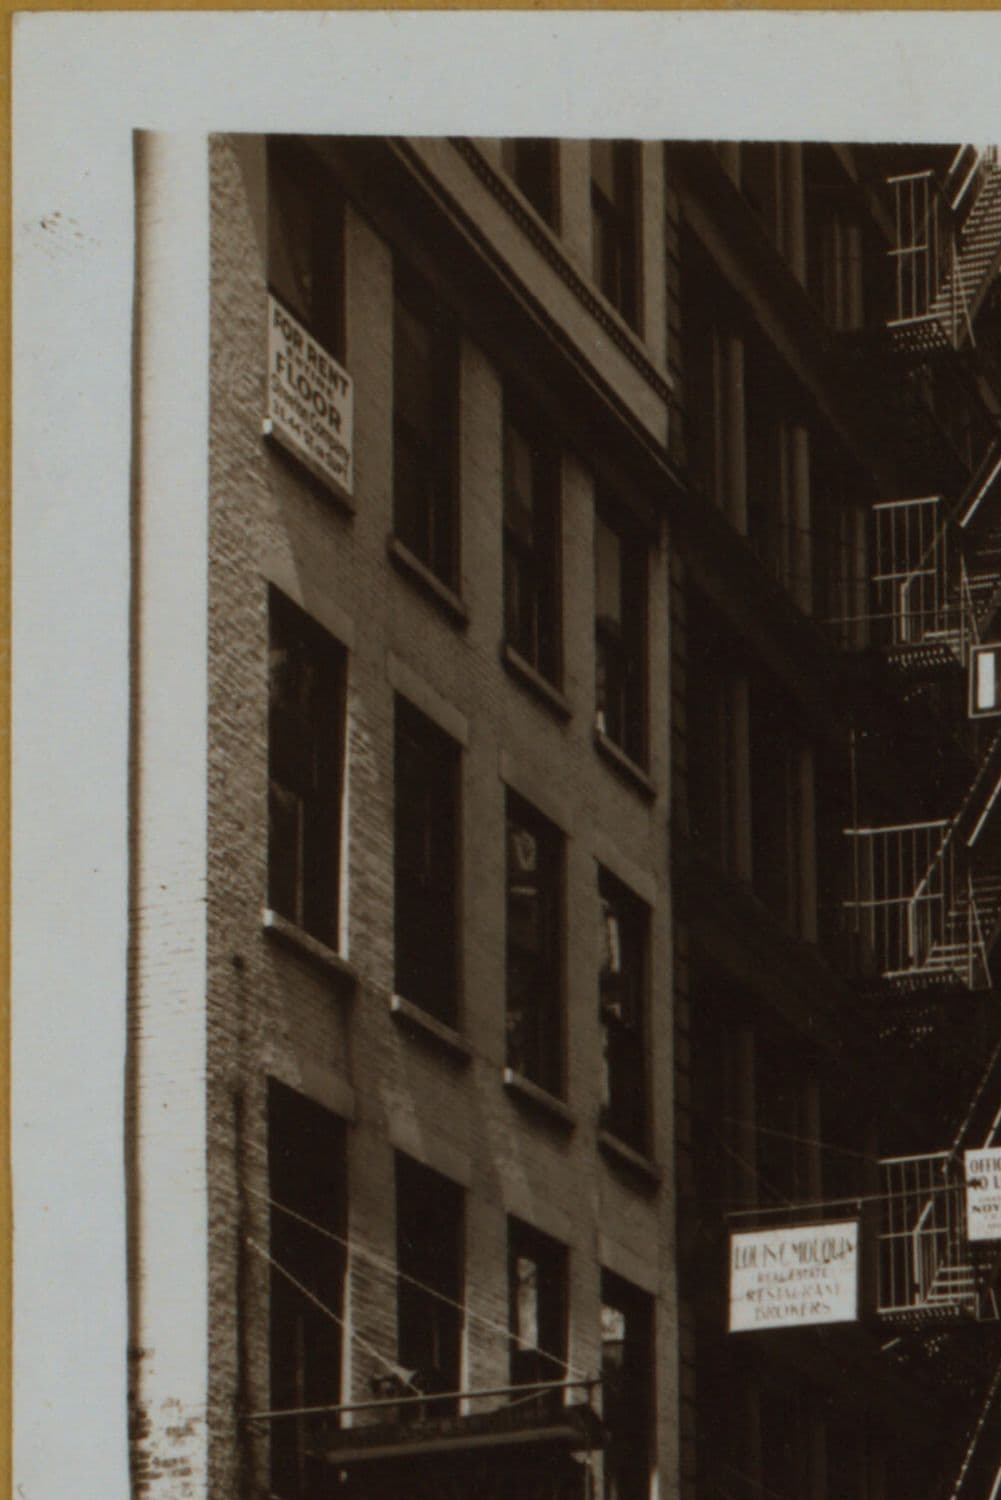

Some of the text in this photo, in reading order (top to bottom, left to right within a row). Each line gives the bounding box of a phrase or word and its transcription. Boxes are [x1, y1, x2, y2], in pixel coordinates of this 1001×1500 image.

[273, 307, 304, 350] FOR
[306, 342, 350, 396] RENT
[275, 350, 341, 434] FLOOR
[968, 1174, 989, 1191] O
[745, 1282, 841, 1305] RESTAURANT
